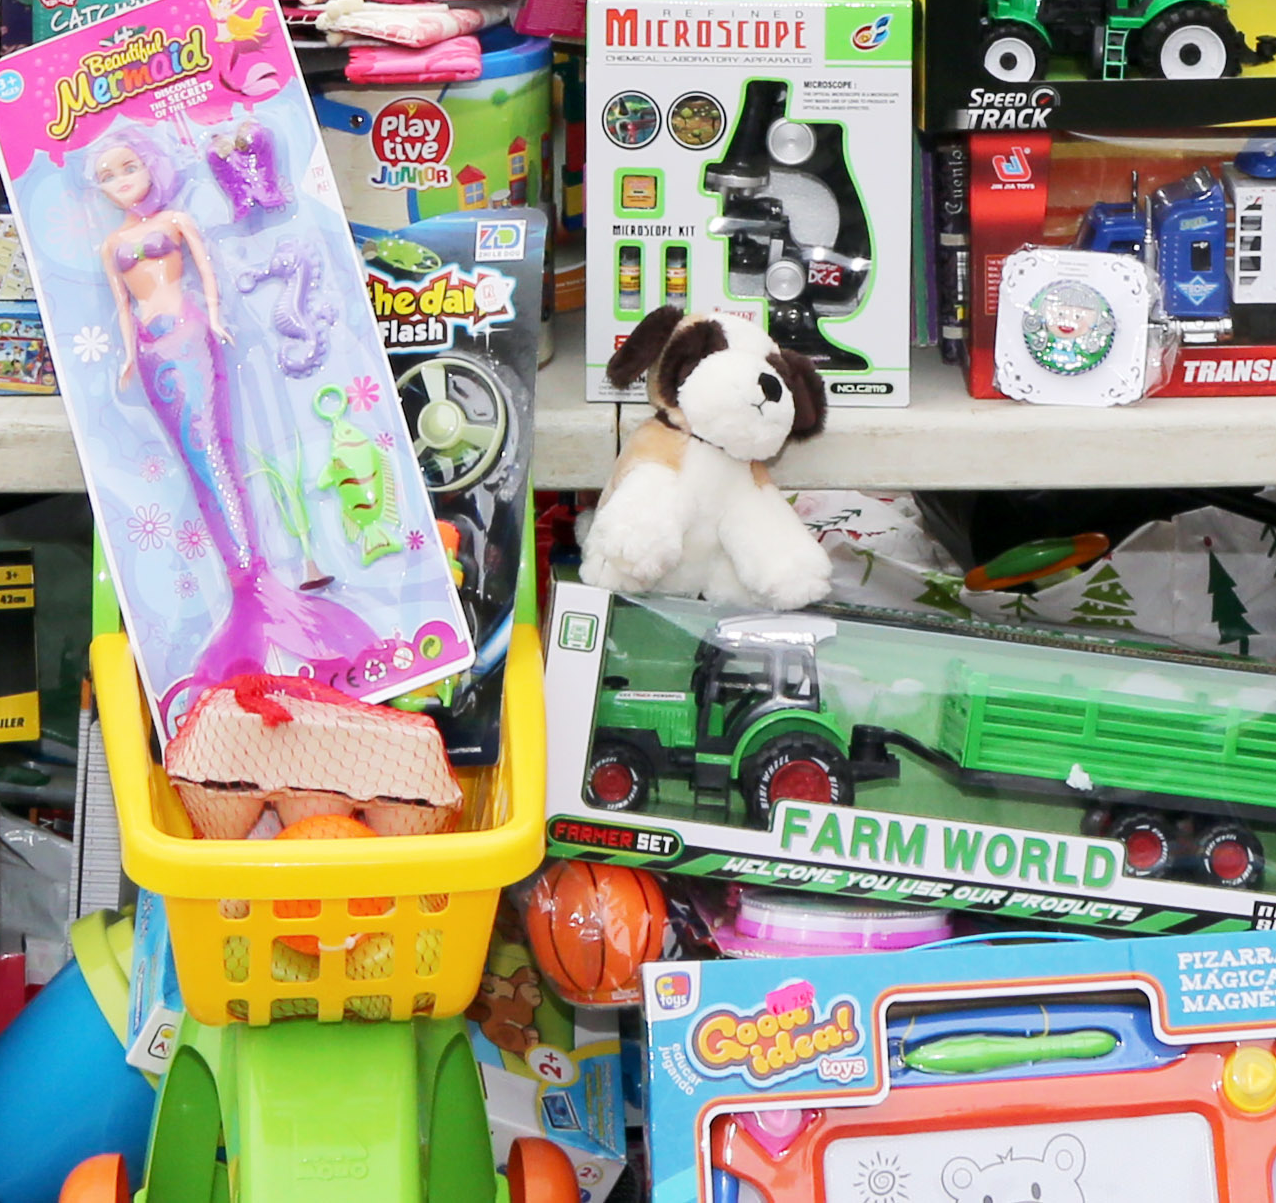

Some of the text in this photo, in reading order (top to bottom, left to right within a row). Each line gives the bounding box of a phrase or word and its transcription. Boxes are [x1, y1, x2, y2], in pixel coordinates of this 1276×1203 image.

[663, 9, 804, 18] REFINED
[605, 7, 807, 49] MICROSCOPE
[84, 32, 164, 77] Beautiful
[605, 55, 813, 64] CHEMICAL LABORATORY APPARATUS
[48, 29, 209, 137] Mermaid
[154, 77, 198, 100] DISCOVER
[803, 81, 852, 89] MICROSCOPE
[149, 80, 214, 113] THE SECRETS
[155, 94, 208, 119] OF THE SEAS
[969, 88, 1028, 108] SPEED
[381, 113, 441, 138] Play
[967, 107, 1052, 129] TRACK
[383, 136, 440, 161] tive
[371, 166, 448, 186] JUNIOR
[613, 224, 696, 237] MICROSCOPE KIT
[5, 571, 19, 581] 3+
[554, 822, 674, 854] FARMER SET
[780, 806, 1117, 889] FARM WORLD
[723, 857, 1143, 922] WELCOME YOU USE OUR PRODUCTS
[660, 993, 688, 1009] toys
[749, 1005, 855, 1075] idea!
[537, 1051, 564, 1079] 2+
[658, 1044, 695, 1097] jugando
[673, 1042, 704, 1087] educar
[821, 1057, 865, 1080] toys
